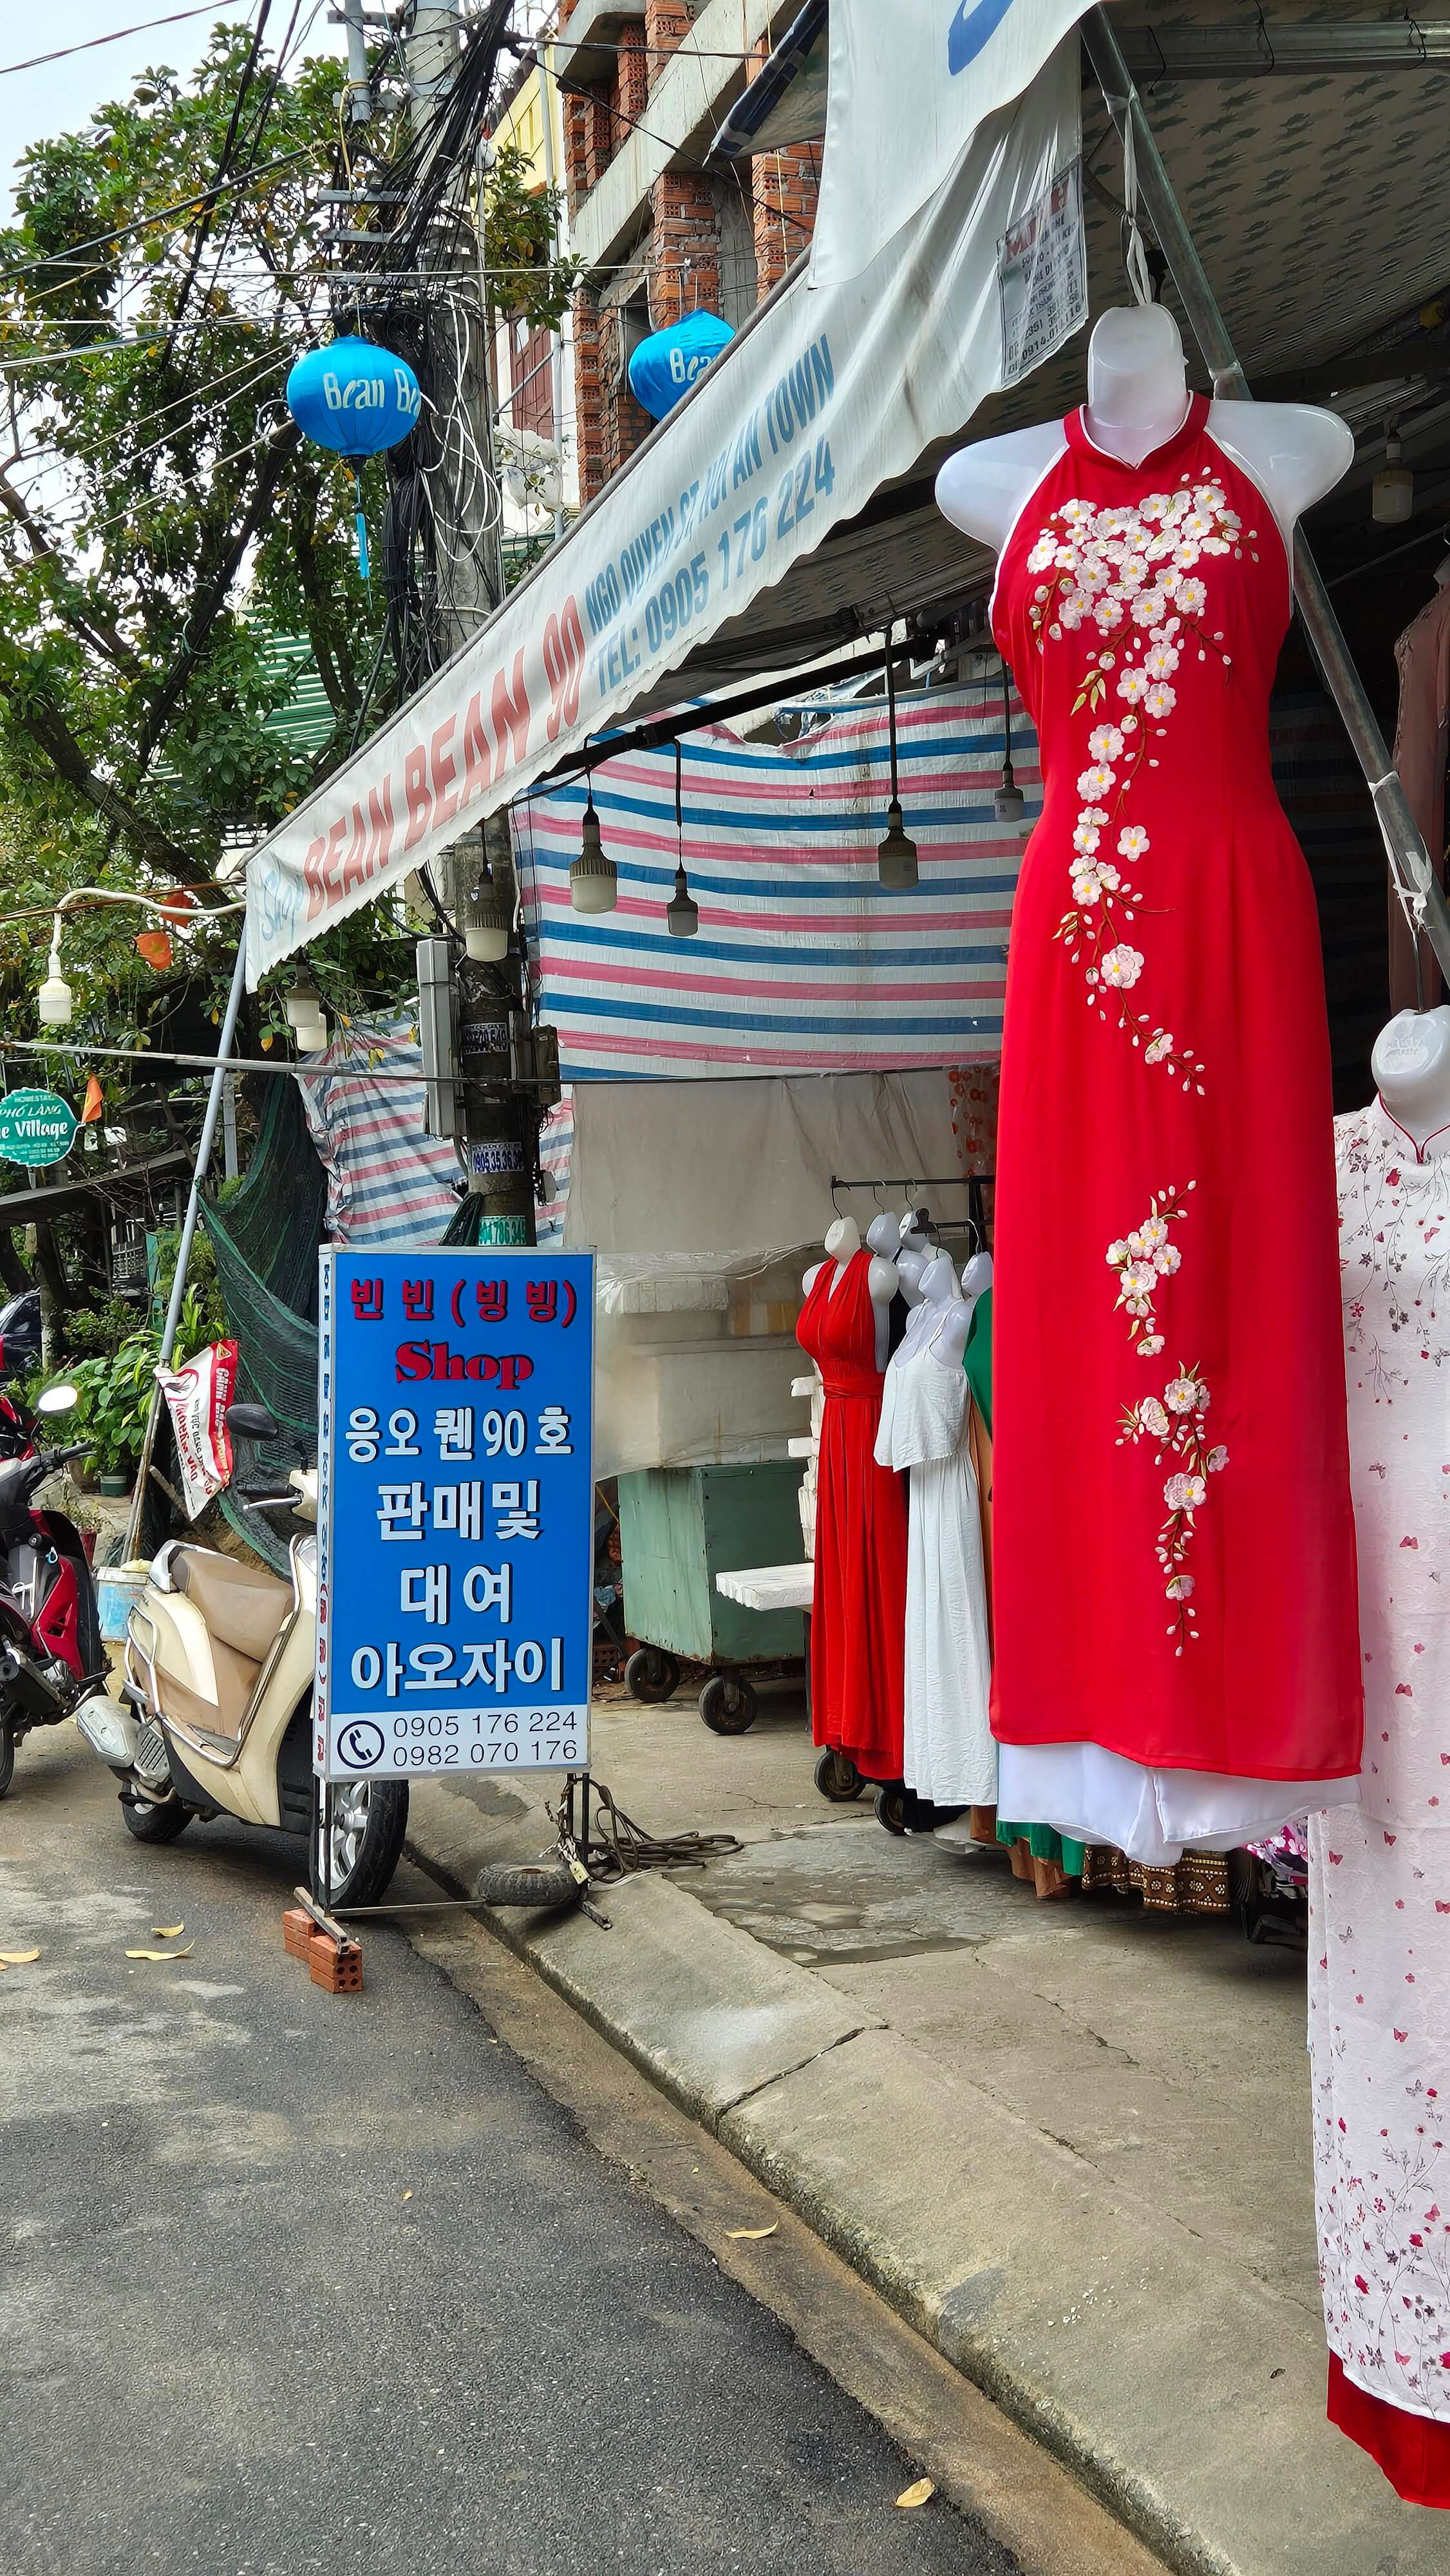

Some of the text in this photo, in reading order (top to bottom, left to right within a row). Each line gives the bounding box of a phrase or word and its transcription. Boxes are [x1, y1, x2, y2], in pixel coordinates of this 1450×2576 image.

[669, 348, 713, 384] Bea
[323, 372, 386, 411] Bean
[586, 562, 621, 636] NGO
[733, 407, 763, 491] AN
[764, 333, 836, 455] TOWN
[596, 432, 835, 697] TEL: 0905 176 224
[305, 773, 395, 923] BEAN
[404, 645, 531, 852] BEAN
[543, 593, 586, 743] 90
[14, 1119, 68, 1141] Village
[395, 1339, 534, 1390] Shop
[350, 1636, 565, 1698] 아오자이
[393, 1711, 578, 1738] 0905 176 224
[393, 1739, 577, 1766] 0982 070 176
